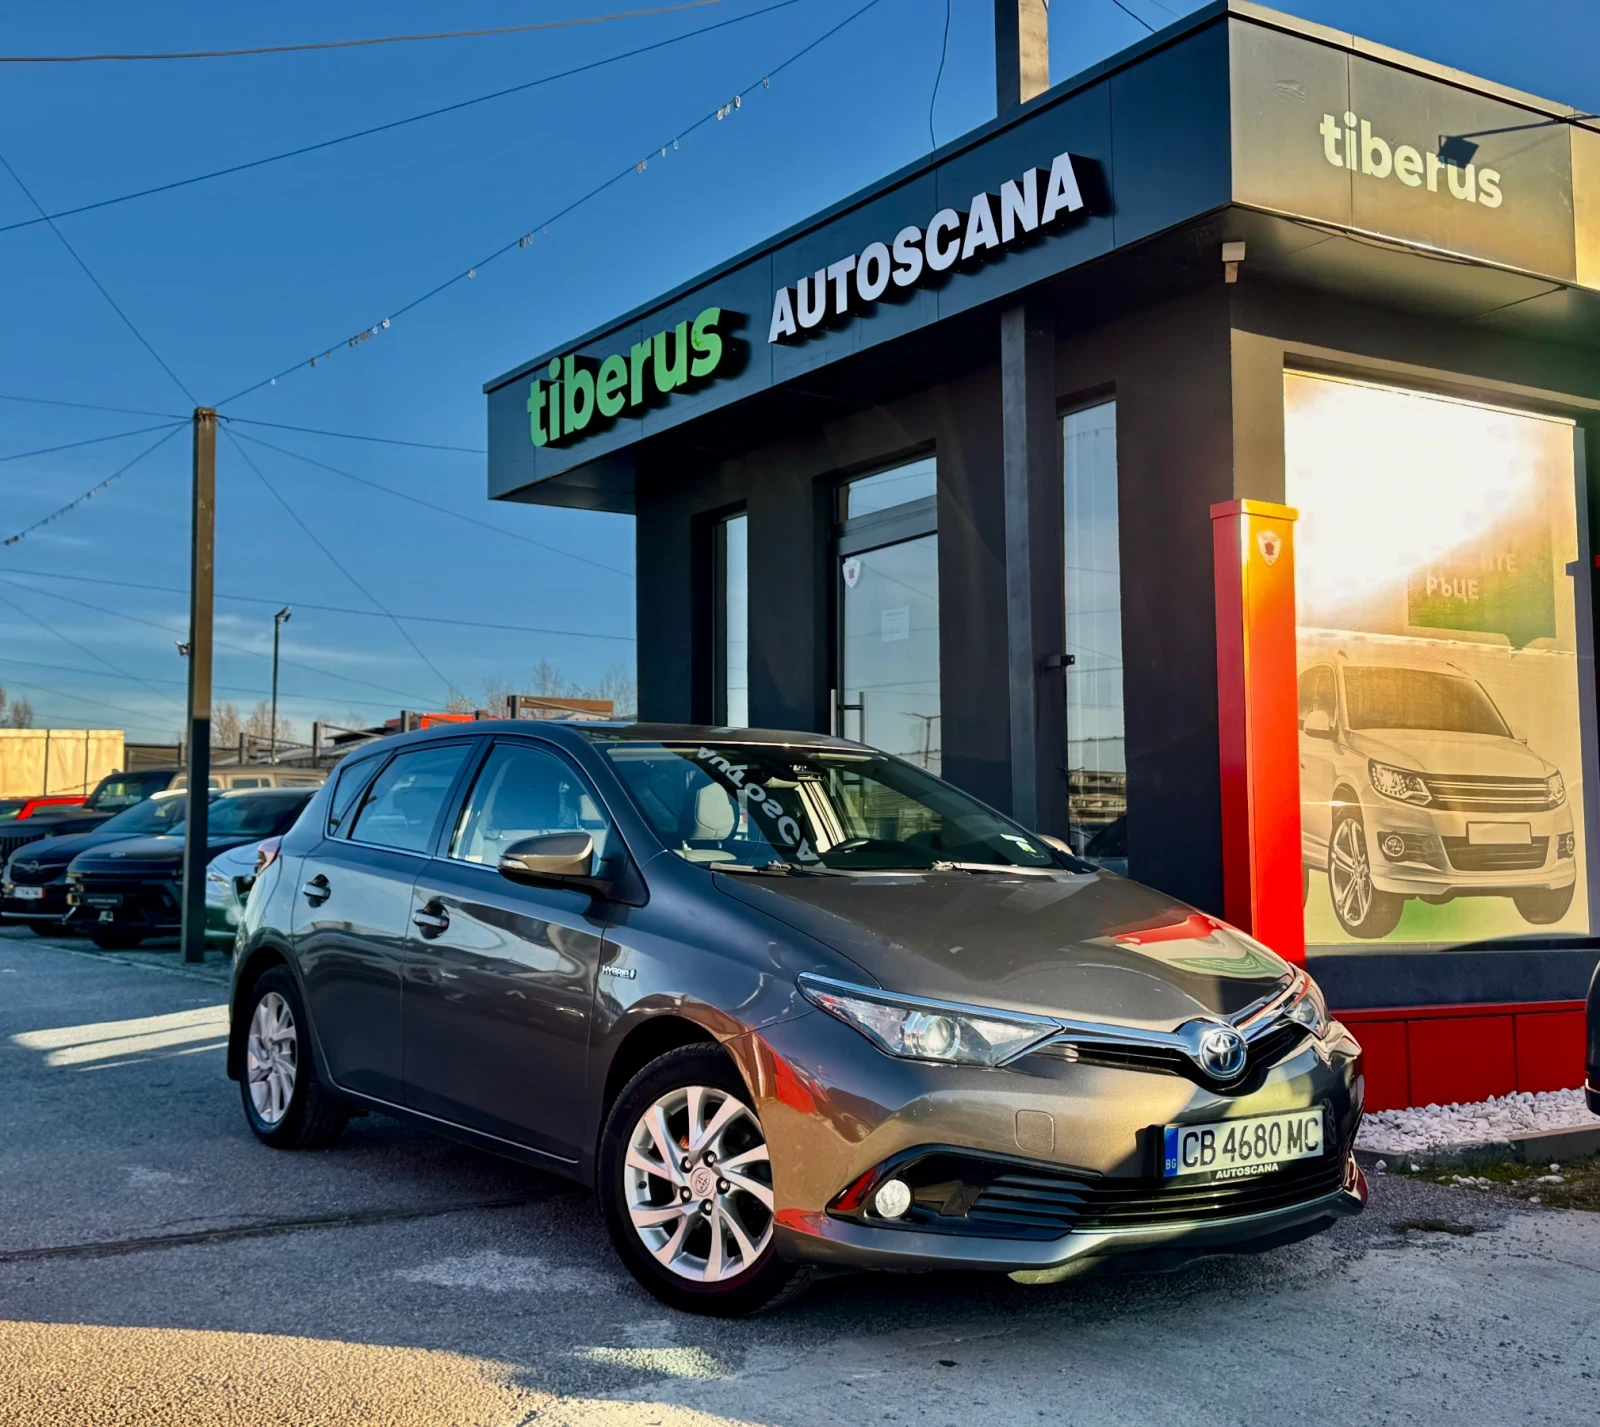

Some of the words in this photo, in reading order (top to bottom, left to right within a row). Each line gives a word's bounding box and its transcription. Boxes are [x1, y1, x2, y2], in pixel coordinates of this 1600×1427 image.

[1319, 110, 1503, 208] tiberus
[526, 307, 723, 448] tiberus
[767, 151, 1084, 343] AUTOSCANA
[1426, 575, 1480, 603] РЪЦЕ
[1182, 1129, 1217, 1168] CB
[1222, 1121, 1282, 1162] 4680
[1287, 1117, 1319, 1154] MC
[1165, 1158, 1177, 1170] BG
[1215, 1163, 1279, 1179] AUTOSCANA
